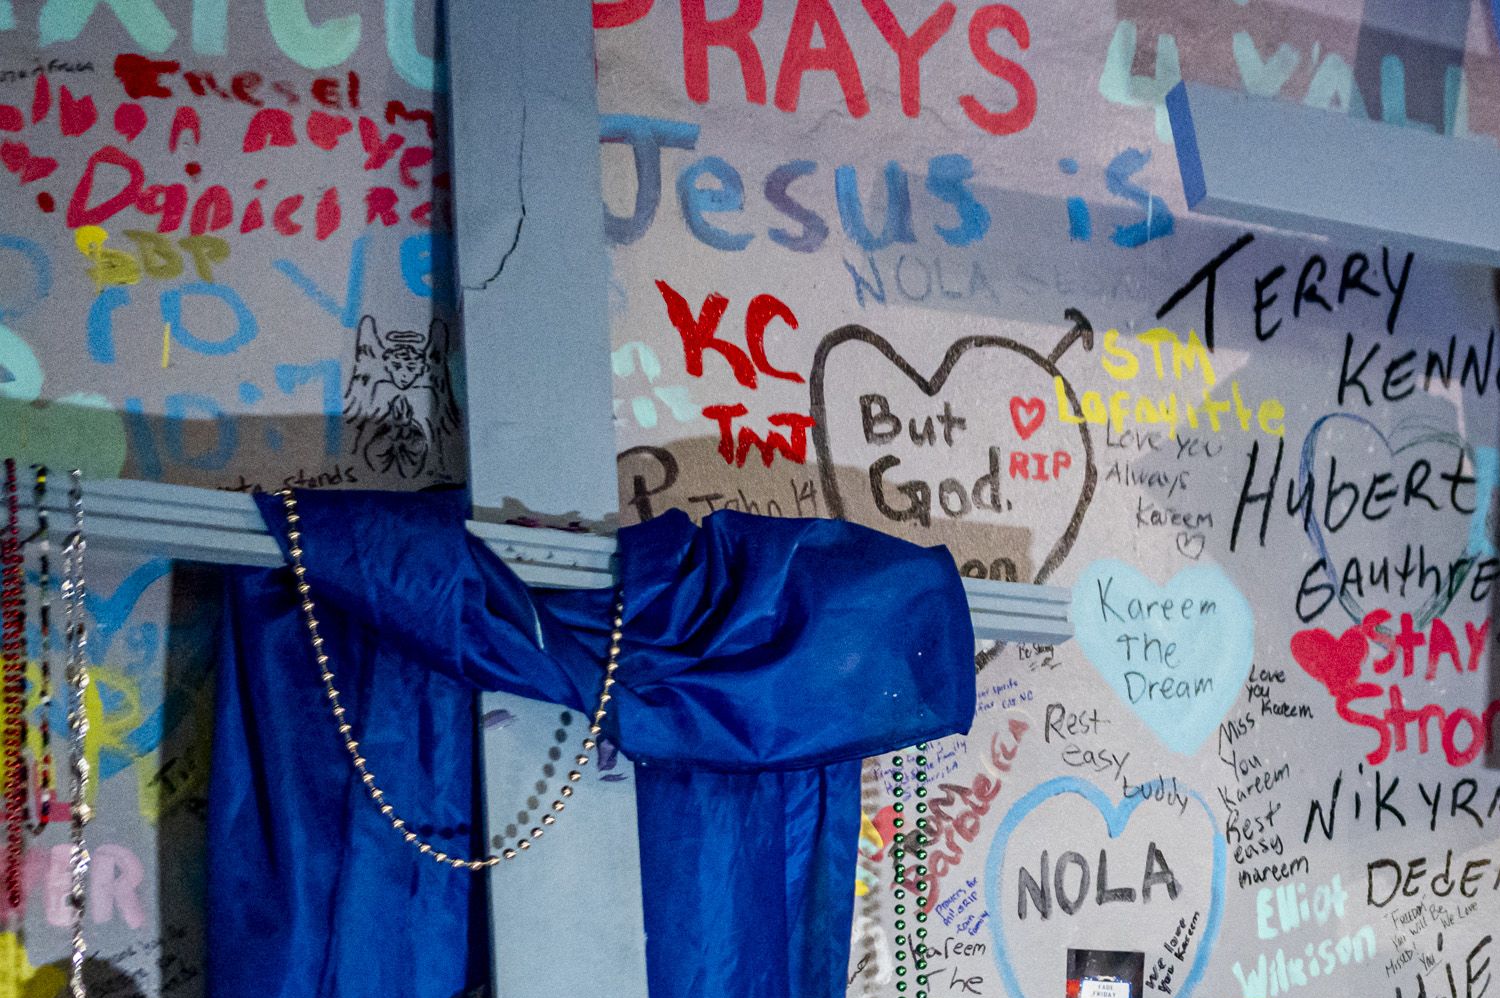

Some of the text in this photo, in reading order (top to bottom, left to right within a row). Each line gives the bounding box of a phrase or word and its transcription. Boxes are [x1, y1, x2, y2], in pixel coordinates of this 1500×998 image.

[599, 111, 1175, 253] Jesus is
[1156, 233, 1416, 354] TERRY
[654, 278, 806, 389] KC
[1102, 327, 1218, 387] STM
[858, 394, 967, 447] But
[1008, 451, 1073, 483] RIP
[1105, 460, 1191, 498] Always
[1097, 576, 1218, 623] Kareem
[1124, 671, 1215, 704] Dream
[1044, 702, 1111, 744] Rest
[1062, 743, 1131, 781] easy
[1017, 841, 1183, 921] NOLA
